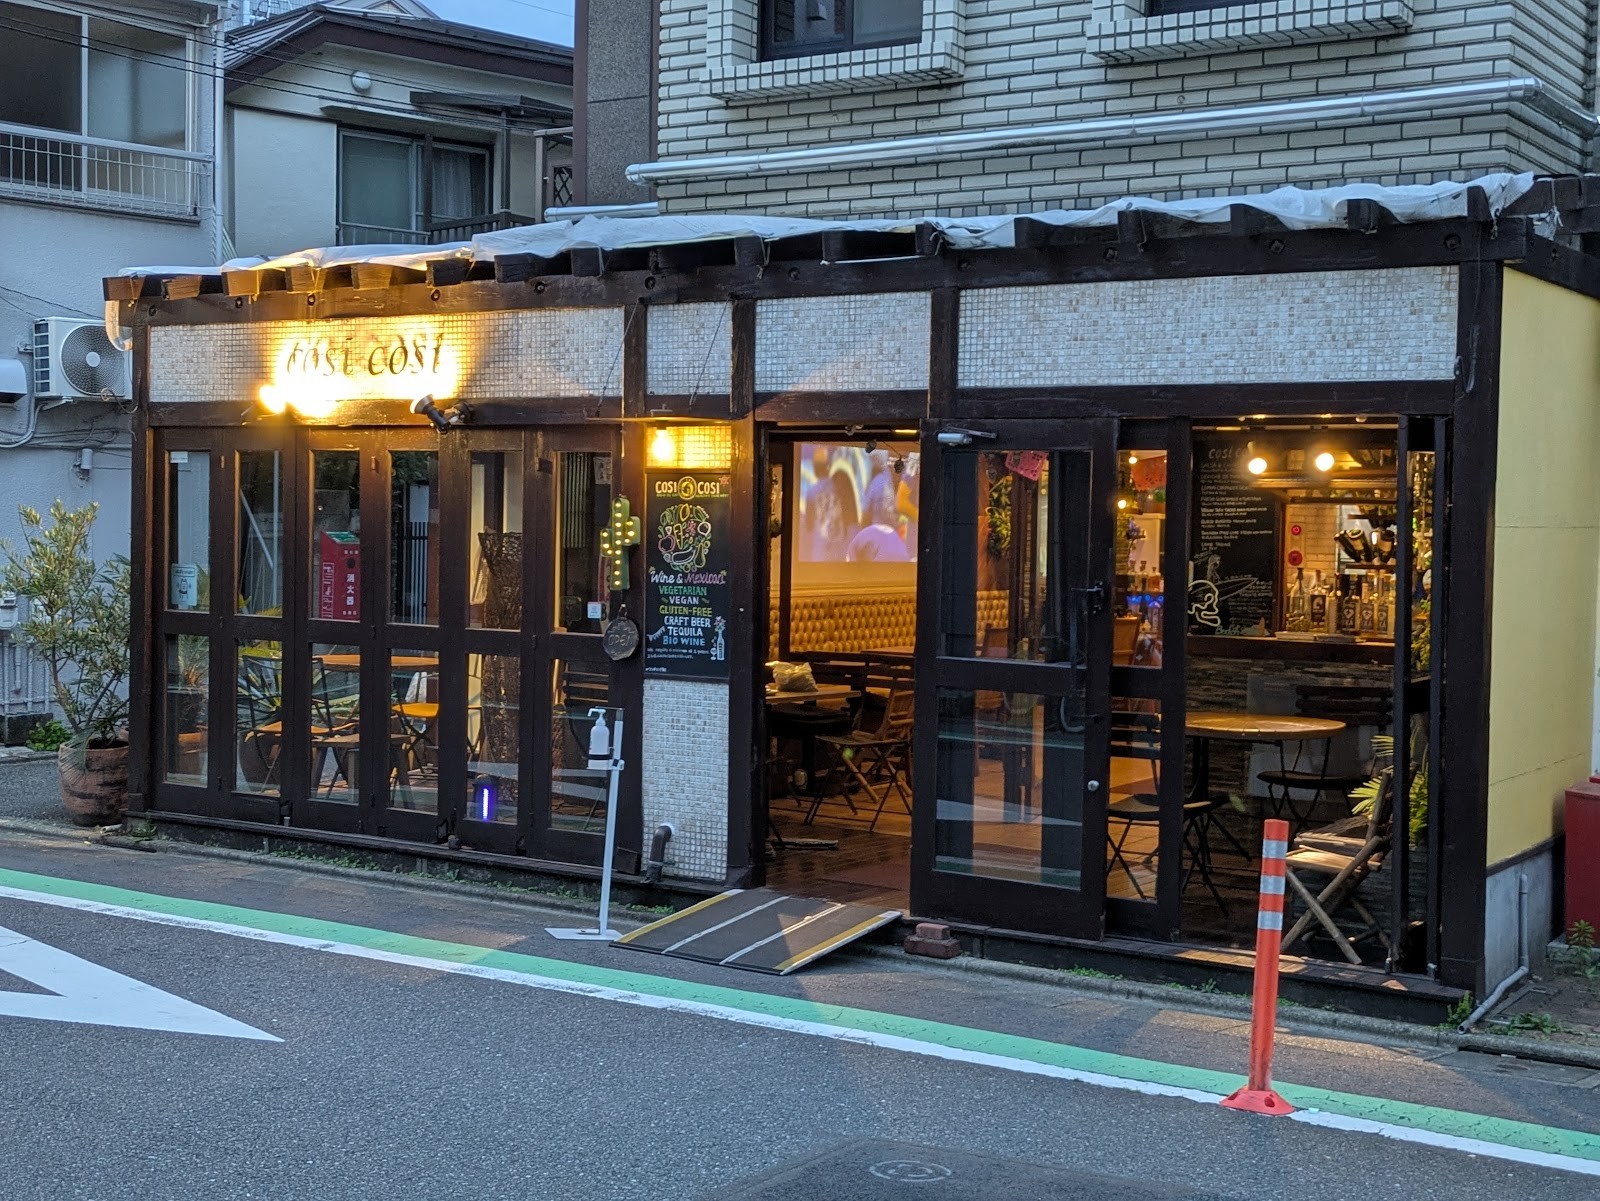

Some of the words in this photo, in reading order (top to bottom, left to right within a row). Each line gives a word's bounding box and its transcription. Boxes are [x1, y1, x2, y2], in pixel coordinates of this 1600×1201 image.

[655, 481, 677, 494] COSI
[697, 482, 720, 494] COSI
[650, 570, 675, 584] Wine
[676, 573, 683, 584] &
[346, 573, 355, 606] 消火器
[658, 585, 708, 596] VEGETARIAN
[669, 596, 699, 605] VEGAN
[659, 605, 713, 618] GLUTEN-FREE
[664, 615, 689, 626] CRAFT
[691, 616, 711, 628] BEER
[667, 626, 703, 637] TEQUILA
[663, 635, 678, 645] BIO
[680, 637, 706, 646] WINE
